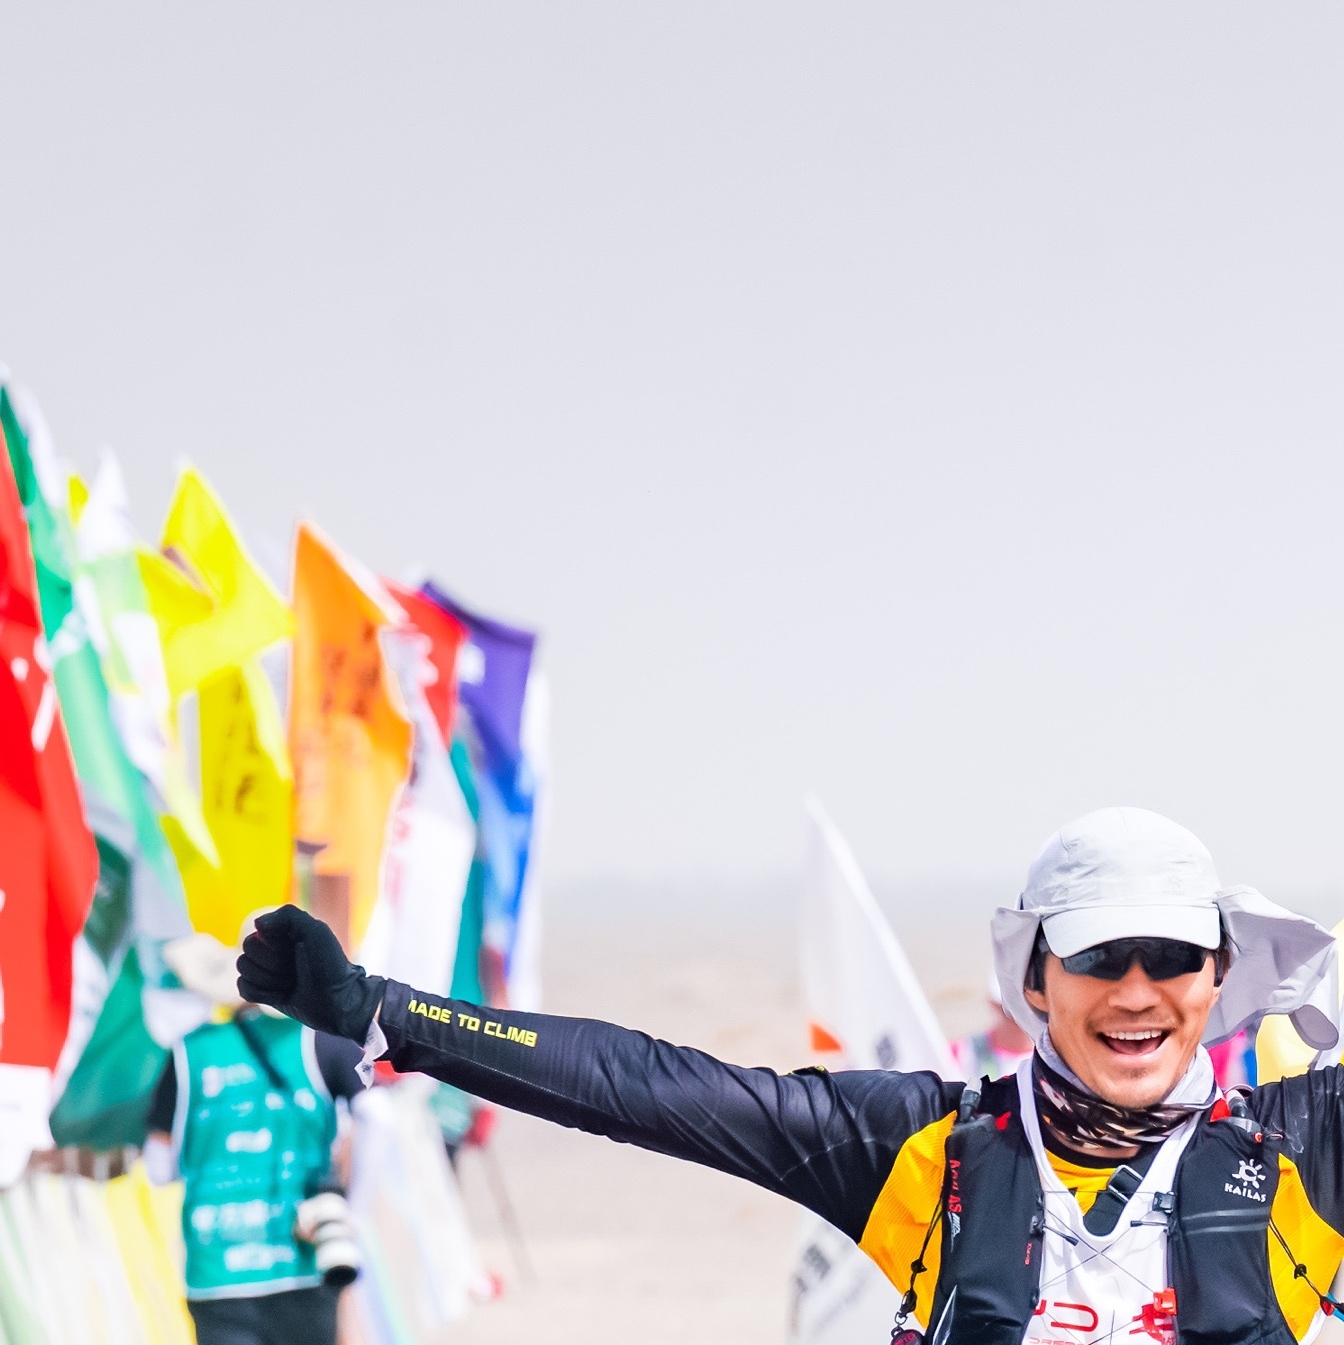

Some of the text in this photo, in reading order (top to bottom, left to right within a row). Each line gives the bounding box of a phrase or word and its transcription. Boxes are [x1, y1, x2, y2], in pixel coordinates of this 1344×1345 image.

[408, 1000, 538, 1048] MADE TO CLIMB
[1224, 1183, 1267, 1203] KAILAS
